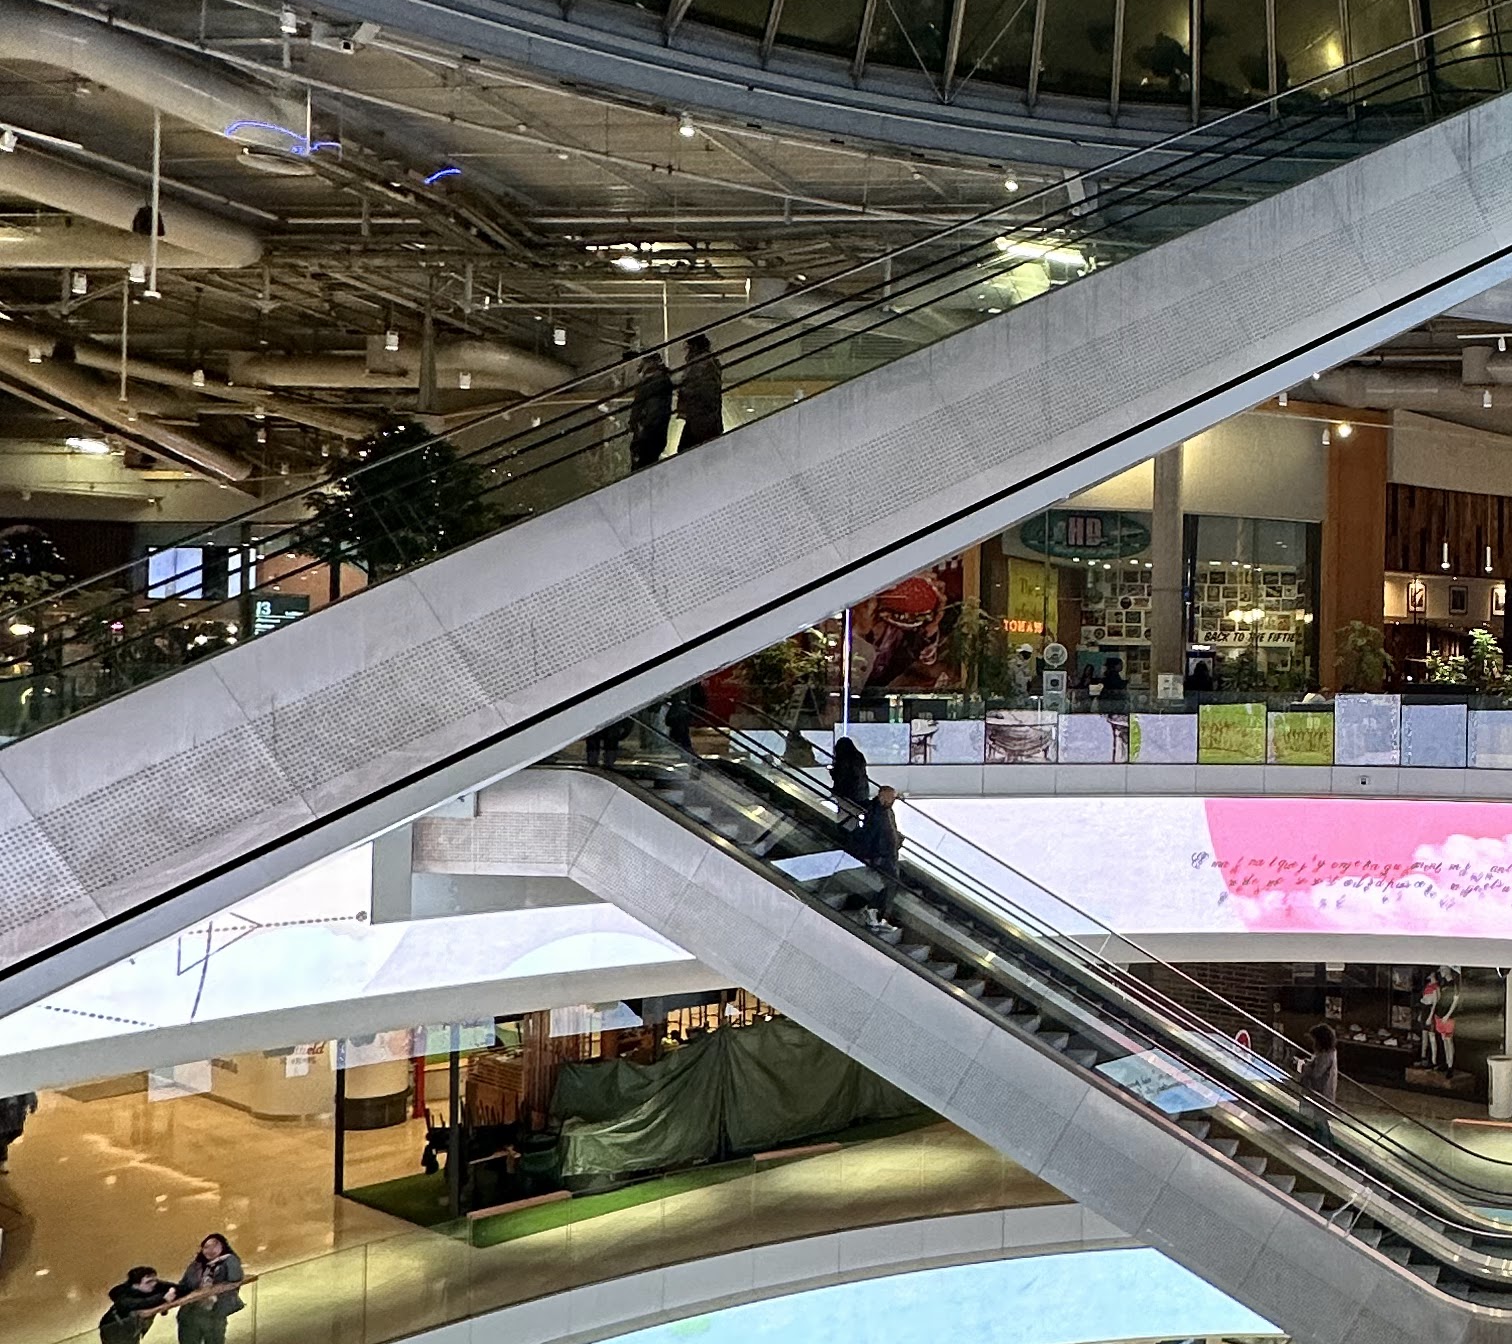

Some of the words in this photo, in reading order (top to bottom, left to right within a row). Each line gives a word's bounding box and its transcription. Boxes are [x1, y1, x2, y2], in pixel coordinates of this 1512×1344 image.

[1203, 631, 1230, 643] BACK
[1233, 632, 1245, 642] TO
[1267, 632, 1297, 643] FIFTIE
